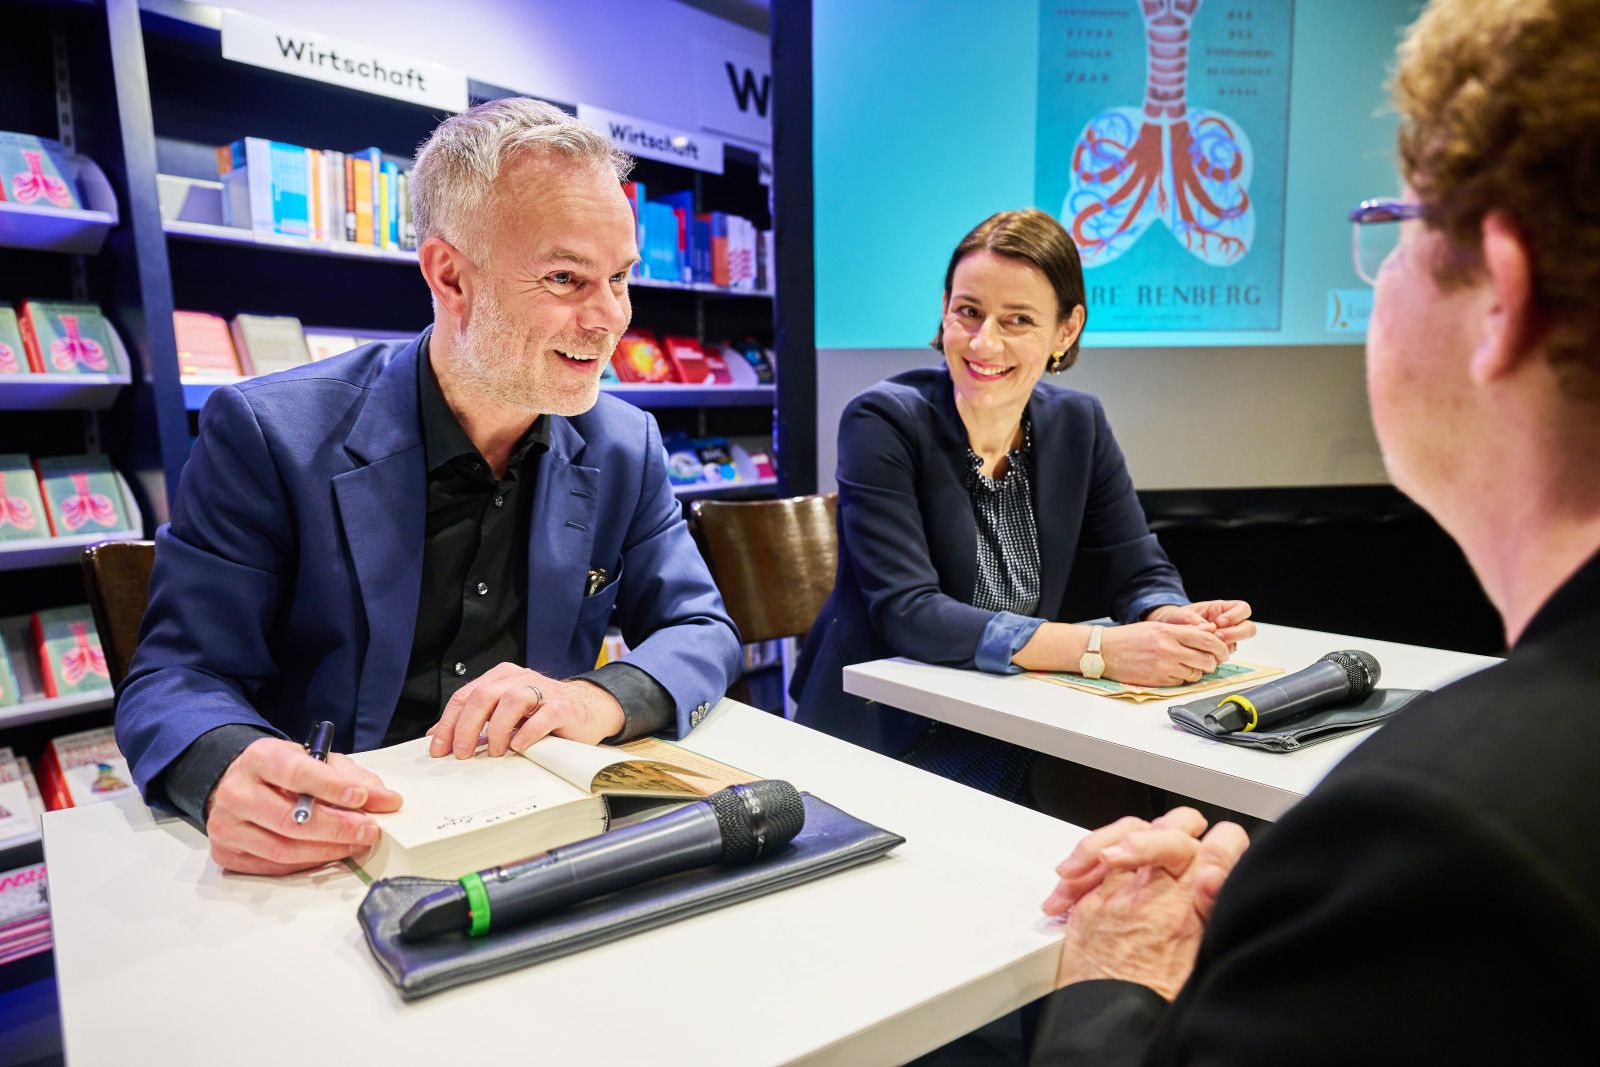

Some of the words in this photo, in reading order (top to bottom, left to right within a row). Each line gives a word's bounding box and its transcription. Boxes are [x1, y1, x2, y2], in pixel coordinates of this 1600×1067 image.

[275, 34, 426, 91] Wirtschaft
[725, 61, 769, 118] W
[1091, 284, 1121, 306] RE
[1137, 284, 1262, 306] RENBERG
